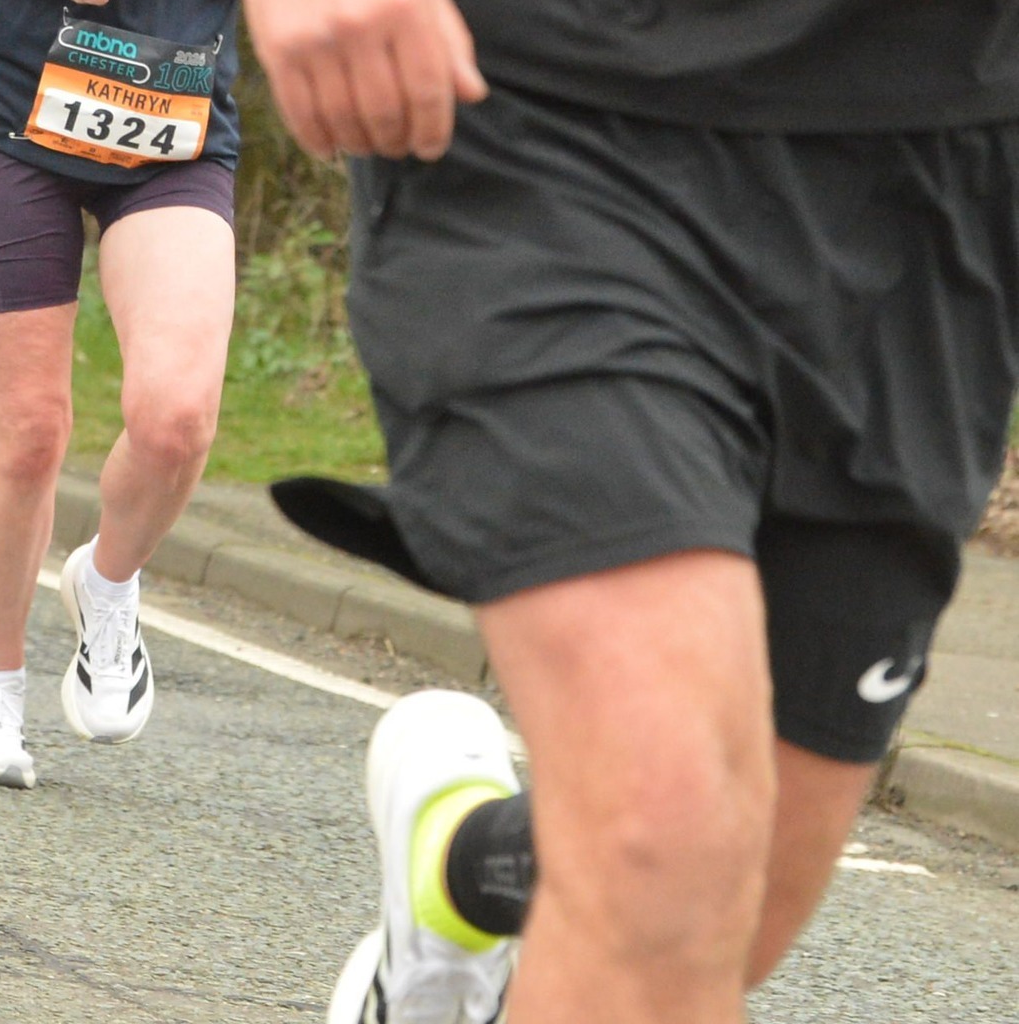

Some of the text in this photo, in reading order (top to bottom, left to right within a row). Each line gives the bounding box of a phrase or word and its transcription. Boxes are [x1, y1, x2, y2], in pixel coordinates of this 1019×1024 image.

[76, 29, 138, 59] mbna
[68, 51, 135, 78] CHESTER
[153, 62, 213, 94] 10K
[86, 79, 172, 114] KATHRYN
[63, 100, 177, 155] 1324
